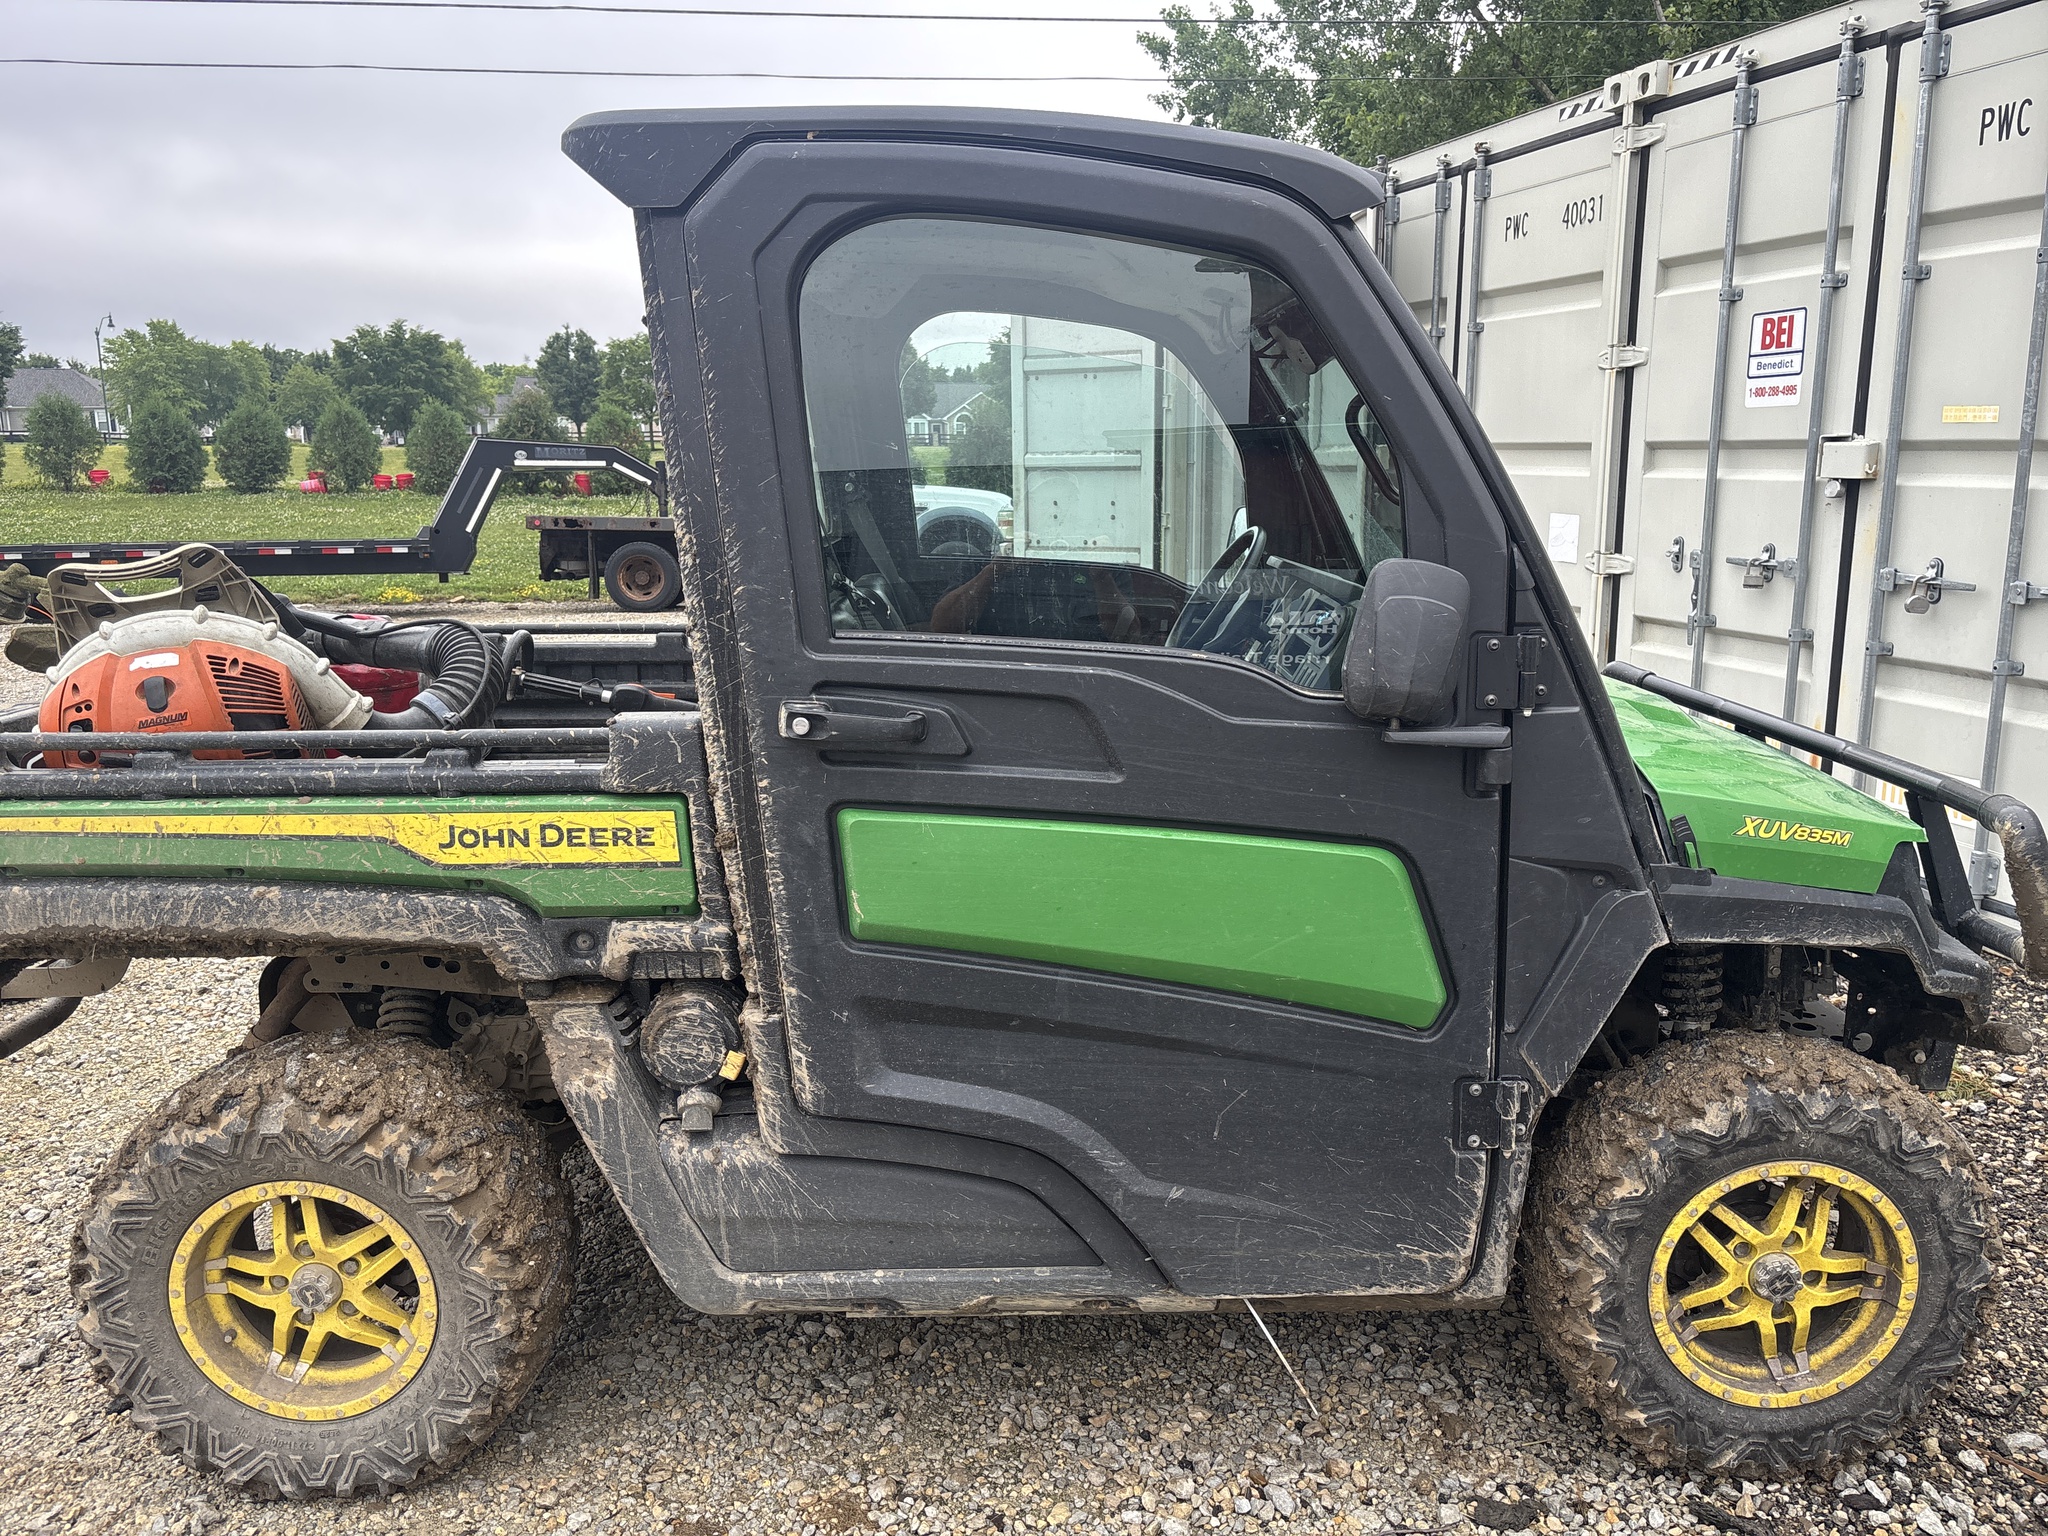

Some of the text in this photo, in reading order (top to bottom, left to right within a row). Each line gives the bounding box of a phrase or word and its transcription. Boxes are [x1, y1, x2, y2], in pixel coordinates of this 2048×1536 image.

[1979, 98, 2033, 146] PWC
[1504, 194, 1603, 242] PWC 40031
[1760, 315, 1795, 350] BEI
[1757, 359, 1794, 371] Benedict
[535, 447, 586, 456] MORITZ
[138, 711, 188, 729] MAGNUM
[438, 824, 656, 850] JOHN DEERE
[1734, 816, 1853, 847] XUV835M
[140, 1168, 243, 1267] BIGHORN
